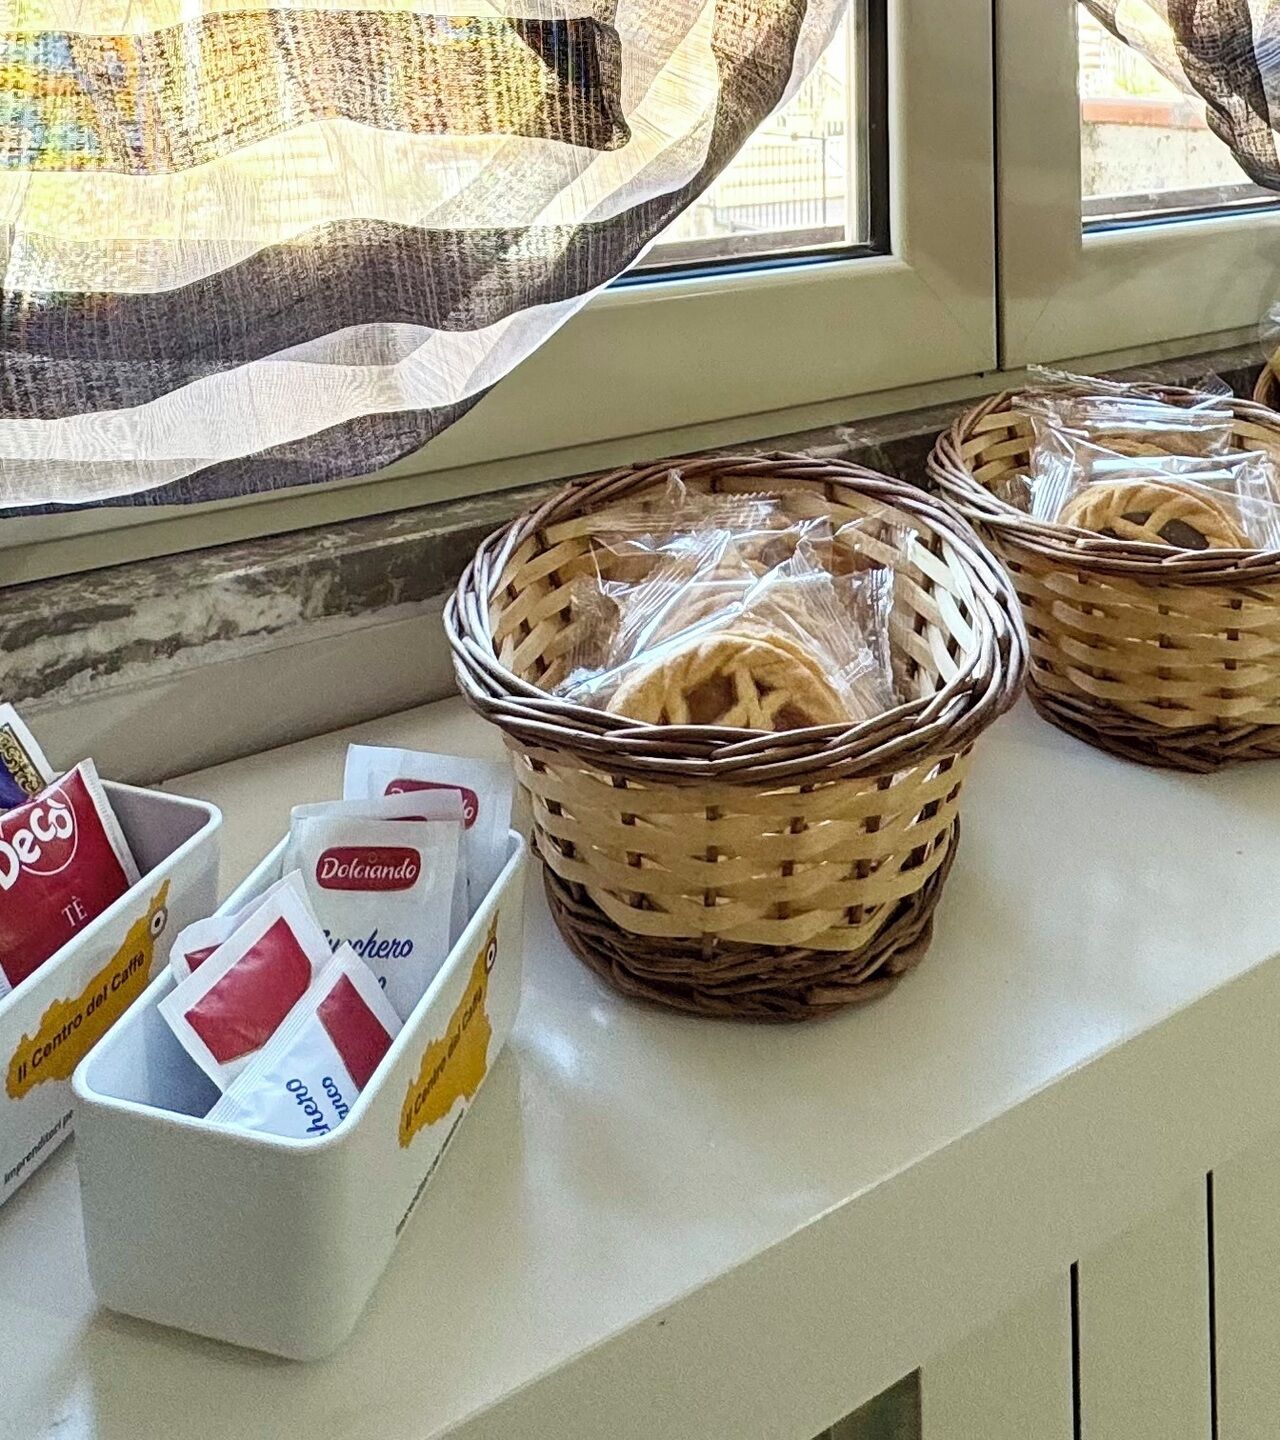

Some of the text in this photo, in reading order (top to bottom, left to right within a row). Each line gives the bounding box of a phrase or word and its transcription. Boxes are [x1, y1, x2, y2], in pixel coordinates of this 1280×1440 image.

[320, 857, 418, 880] Dolciando
[61, 895, 88, 927] TÈ
[32, 1013, 83, 1069] Centro
[86, 985, 108, 1017] del
